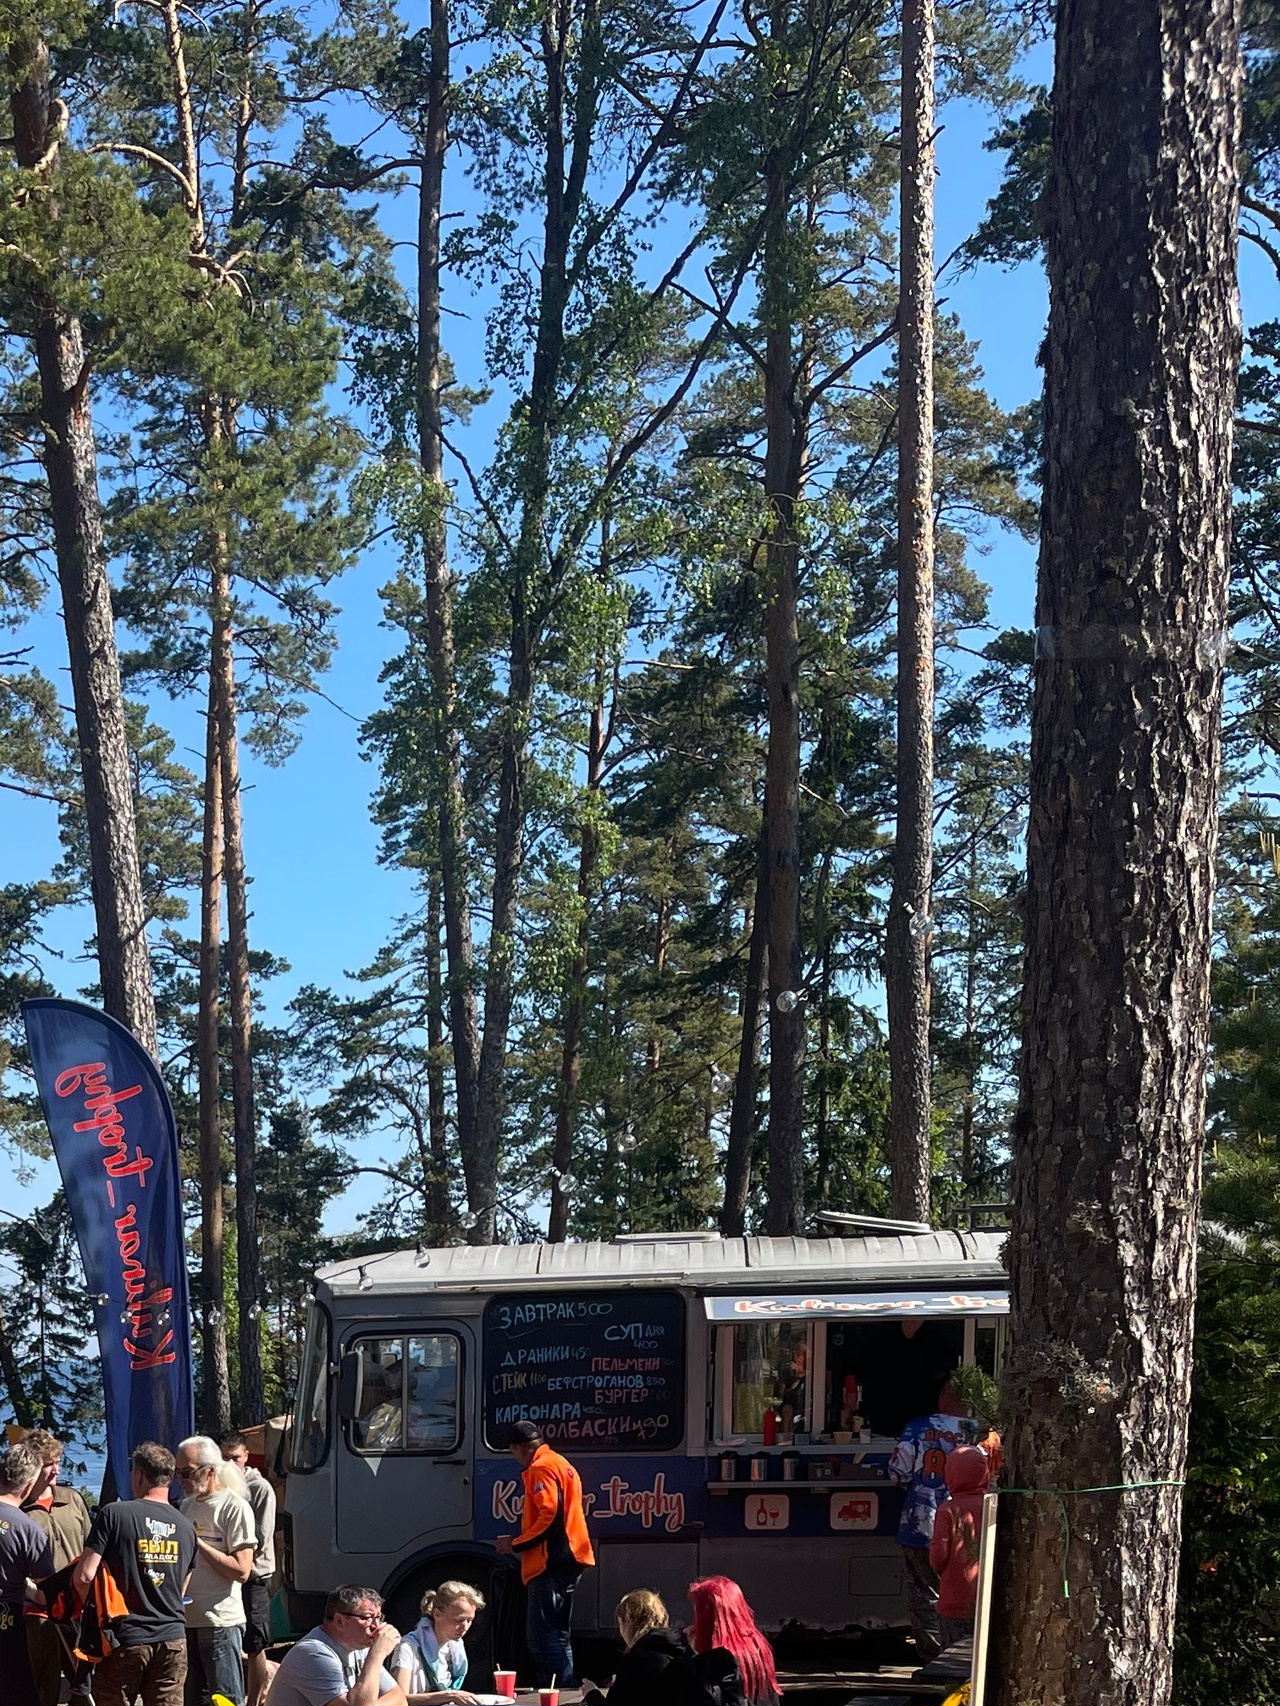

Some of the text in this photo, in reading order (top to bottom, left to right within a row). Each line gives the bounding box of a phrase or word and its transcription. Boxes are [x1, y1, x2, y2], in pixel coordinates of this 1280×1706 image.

[499, 1302, 613, 1330] ЗАВТРАК 500
[604, 1323, 643, 1341] СУП
[634, 1340, 658, 1350] 400
[500, 1345, 591, 1367] ДРАНИКИ 450
[591, 1357, 661, 1372] ПЕЛЬМЕНИ
[547, 1374, 666, 1391] БЕФСТРОГАНОВ 850
[595, 1388, 649, 1404] БУРГЕР
[495, 1402, 581, 1425] КАРБОНАРА
[492, 1472, 685, 1533] Kur_trophy
[138, 1538, 179, 1555] БЫЛ
